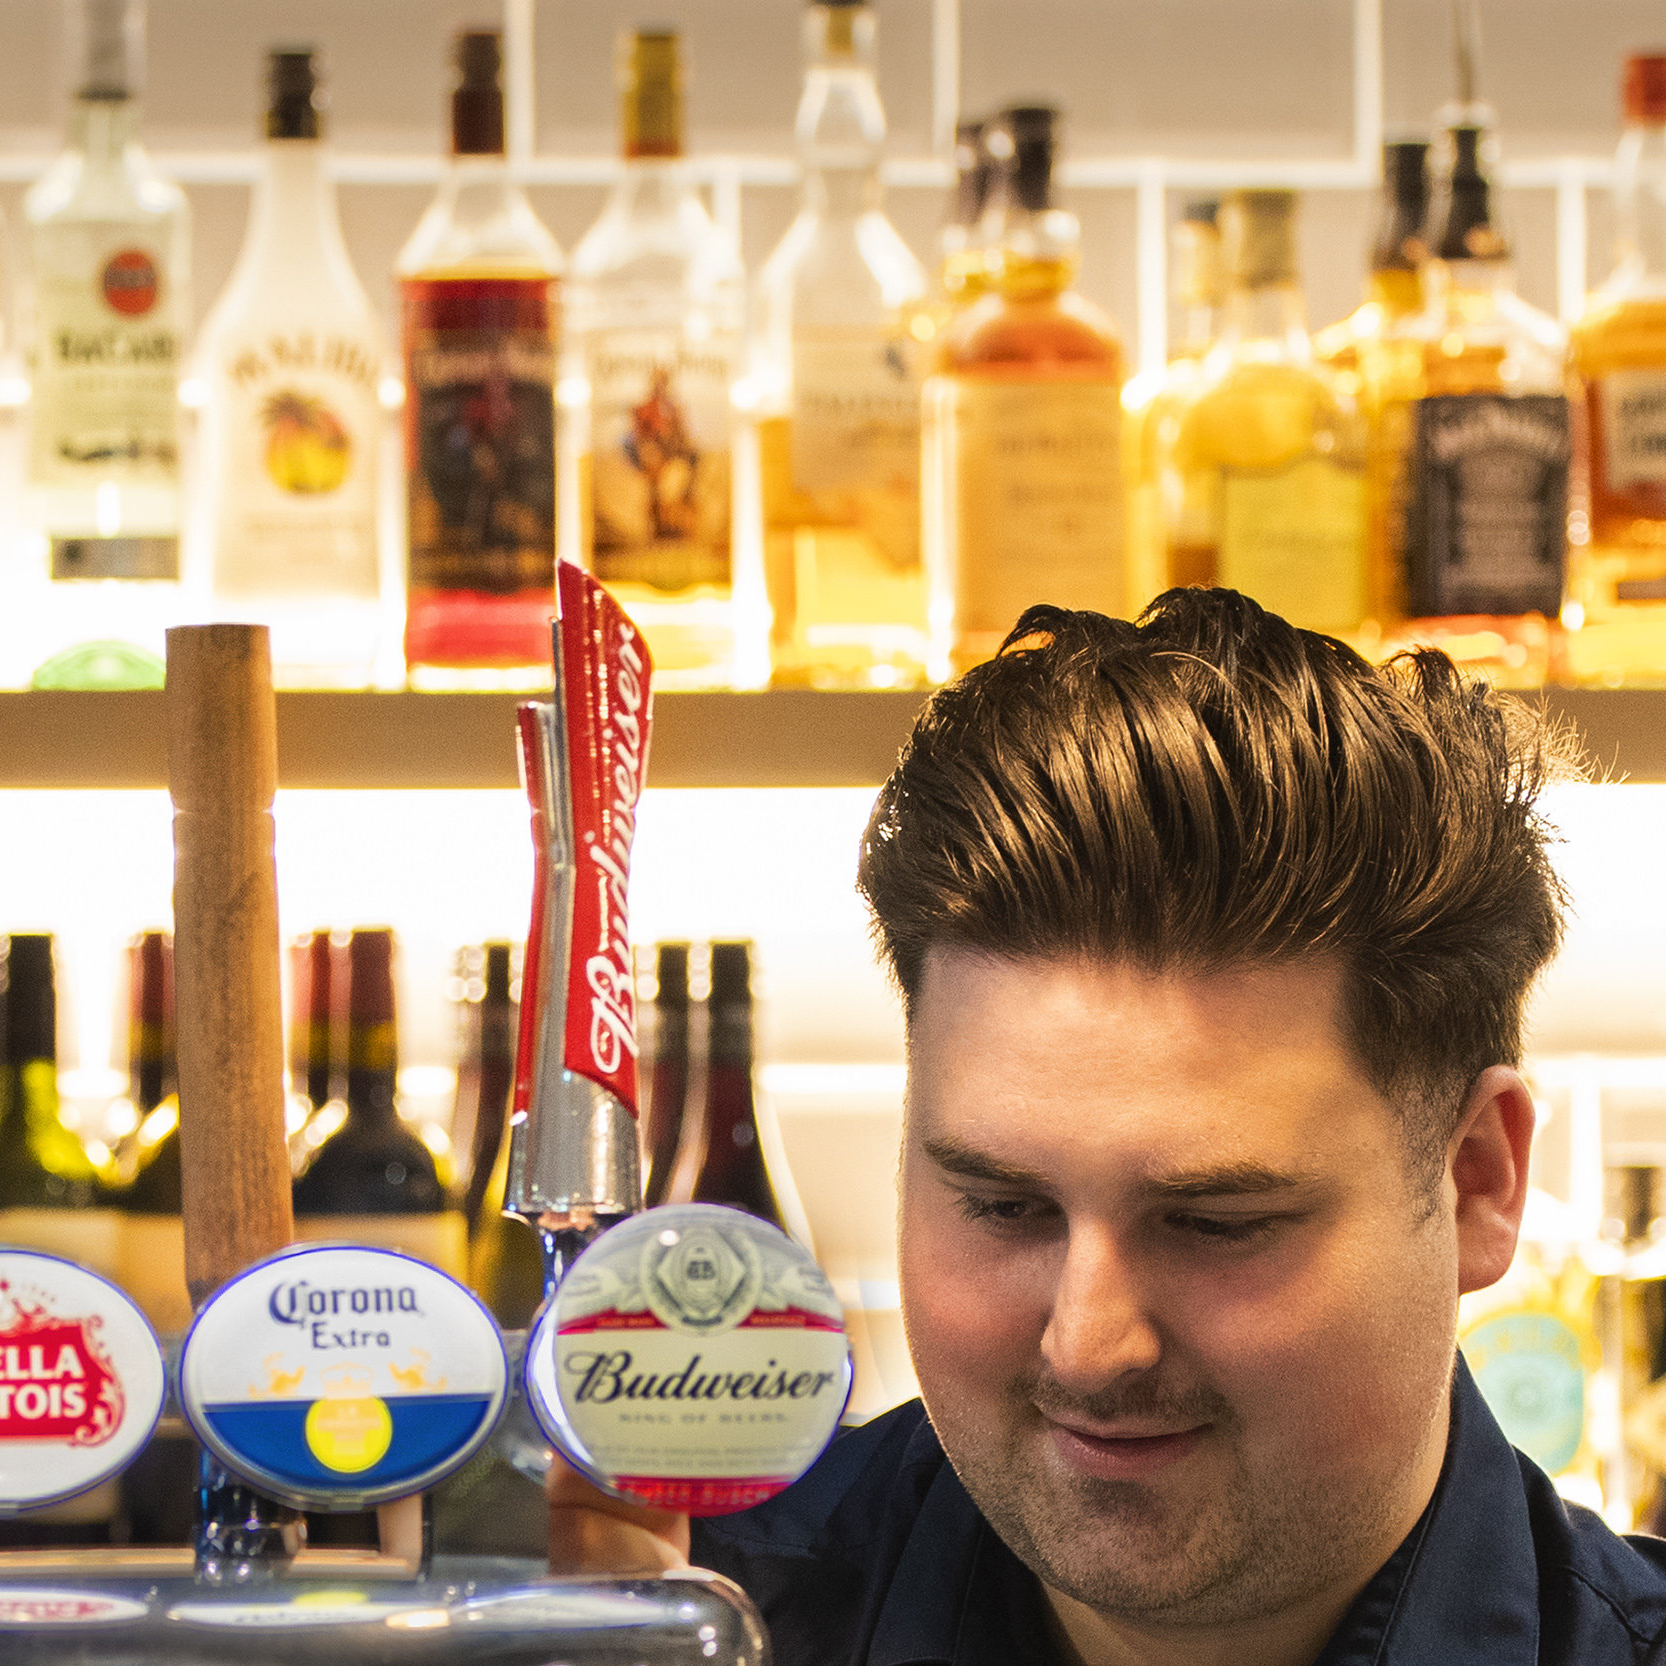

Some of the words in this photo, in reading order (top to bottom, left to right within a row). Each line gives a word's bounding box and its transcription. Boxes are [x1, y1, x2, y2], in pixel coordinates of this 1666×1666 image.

[585, 623, 642, 1073] Budweiser
[269, 1280, 420, 1329] Corona
[311, 1322, 391, 1349] Extra
[564, 1350, 834, 1405] Budweiser
